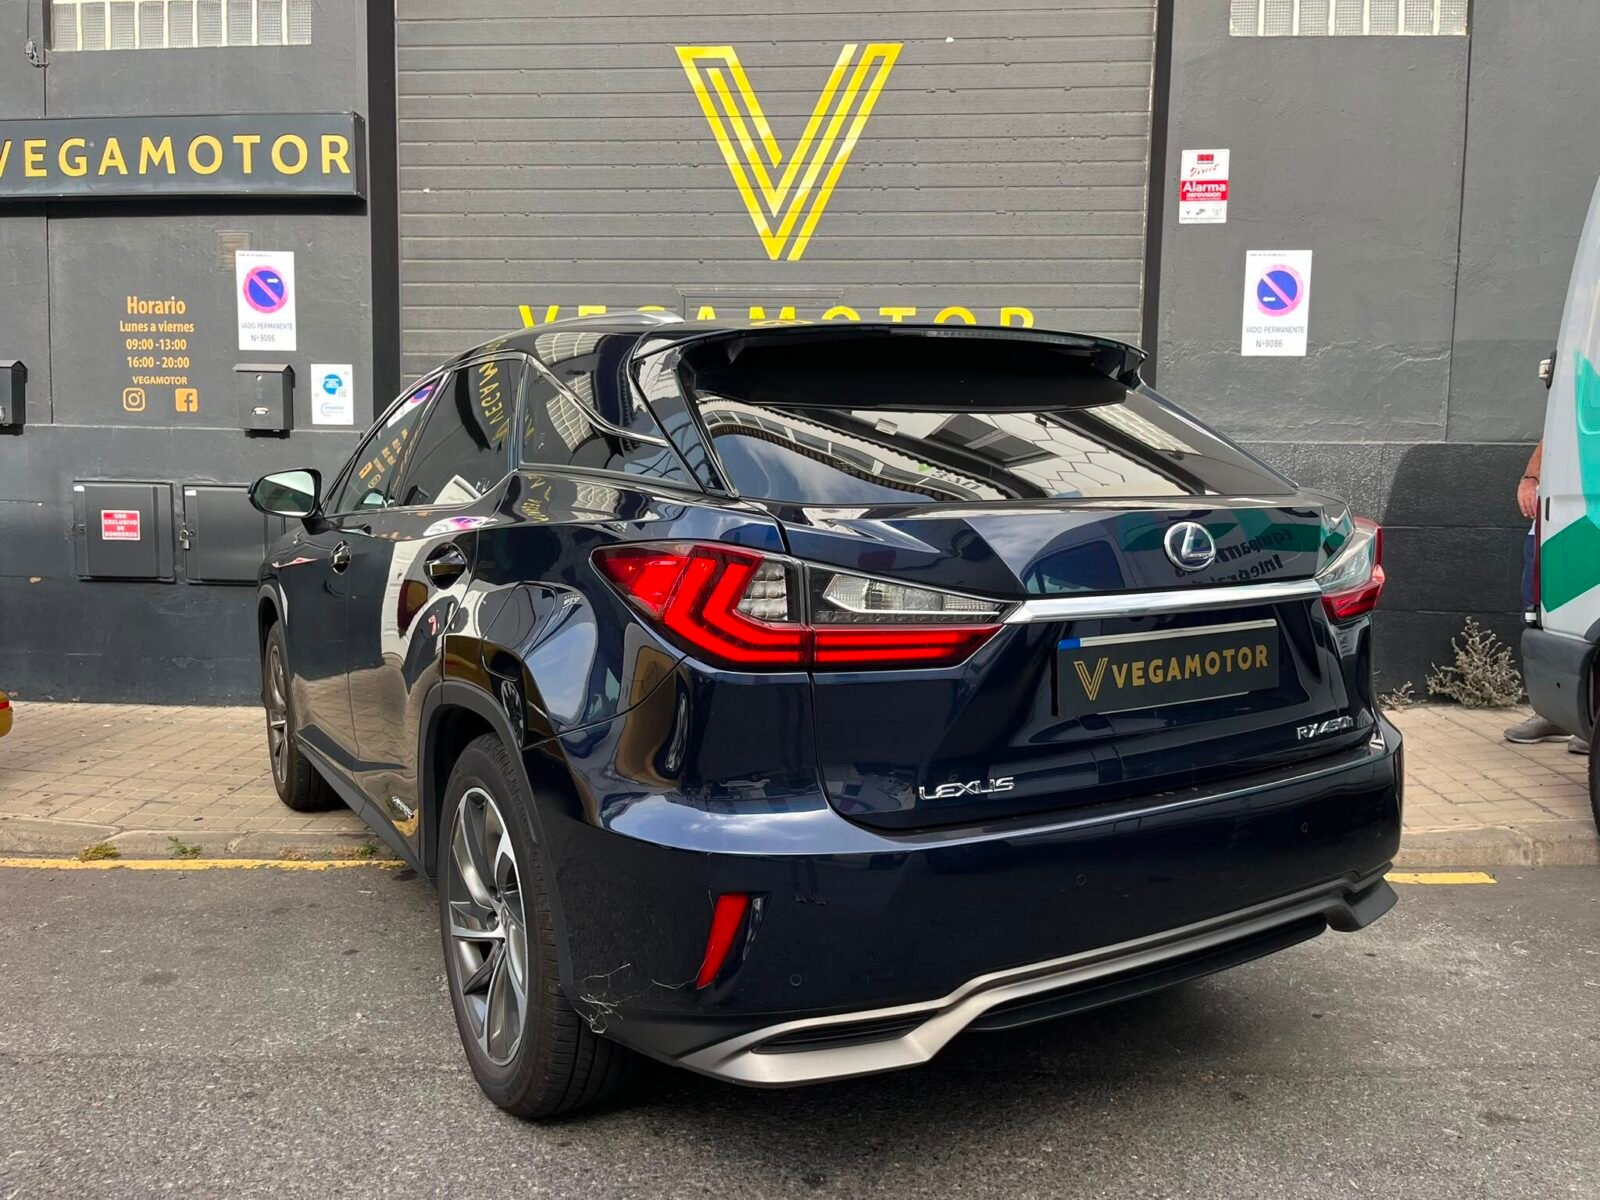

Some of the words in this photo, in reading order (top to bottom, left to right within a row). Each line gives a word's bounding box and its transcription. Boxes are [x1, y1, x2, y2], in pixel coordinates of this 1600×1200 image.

[1182, 181, 1226, 192] Alarma
[126, 295, 186, 315] Horario
[119, 320, 148, 332] Lunes
[149, 323, 156, 332] a
[158, 320, 194, 333] viernes
[257, 322, 293, 330] PERMANENTE
[1246, 326, 1262, 334] VADO
[1263, 326, 1305, 334] PERMANENTE
[126, 338, 154, 350] 09:00
[127, 356, 154, 368] 16:00
[162, 356, 189, 368] 20:00
[132, 376, 187, 385] VEGAMOTOR
[1111, 644, 1269, 688] VEGAMOTOR
[918, 776, 1014, 800] LEXUS
